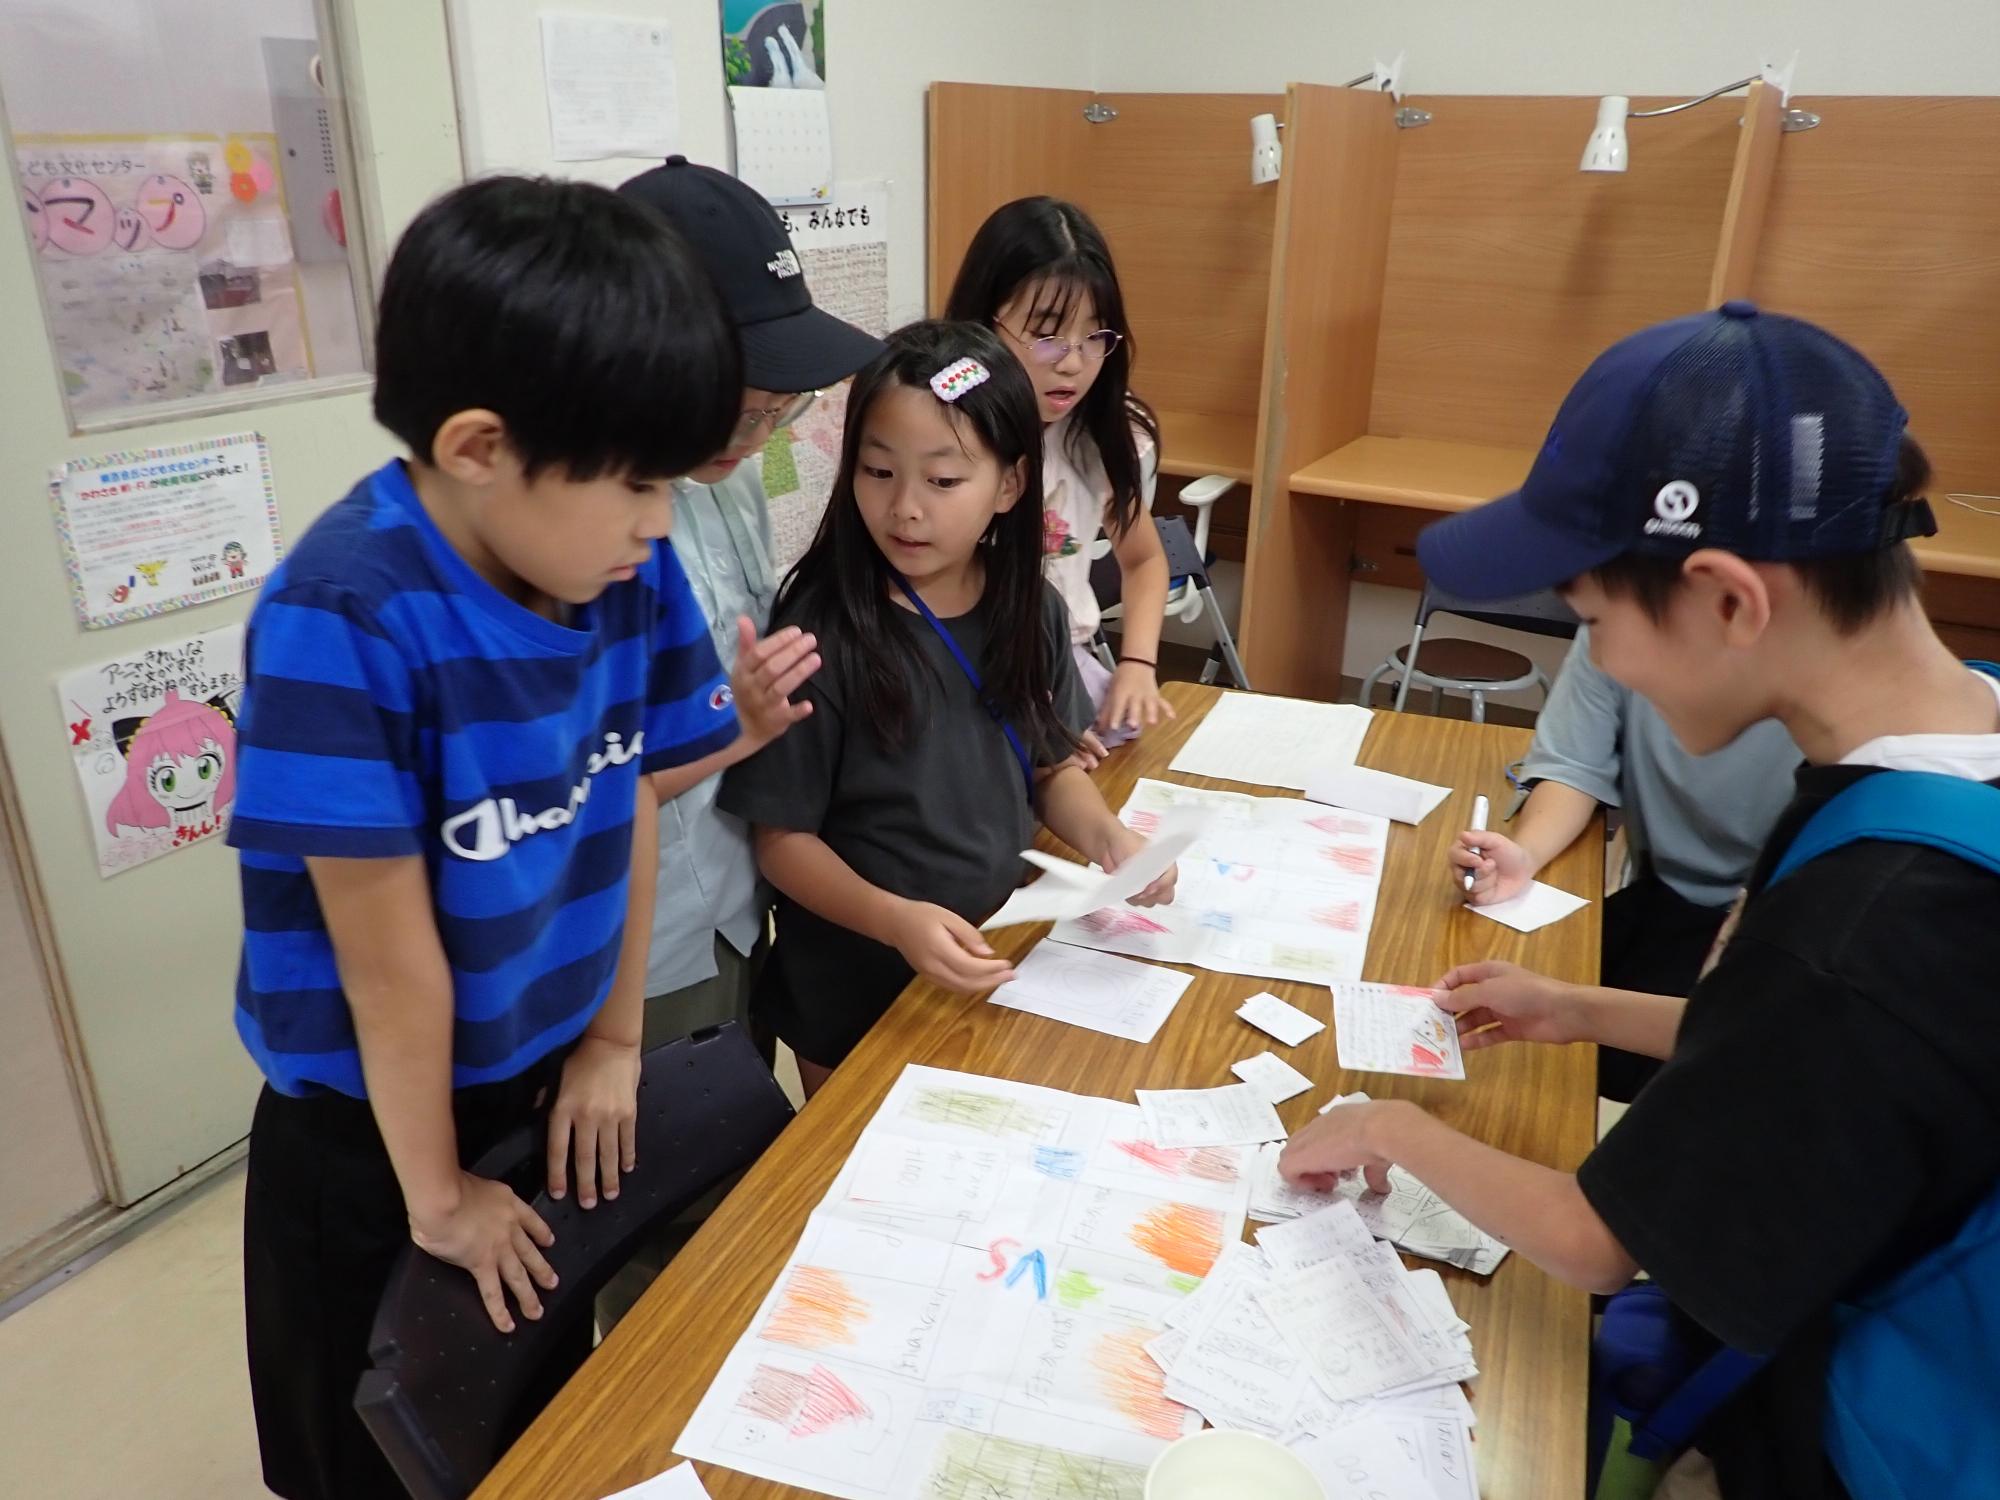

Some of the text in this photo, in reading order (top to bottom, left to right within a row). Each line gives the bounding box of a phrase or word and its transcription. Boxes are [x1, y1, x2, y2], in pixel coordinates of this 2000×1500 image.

[19, 159, 146, 176] ども文化センター
